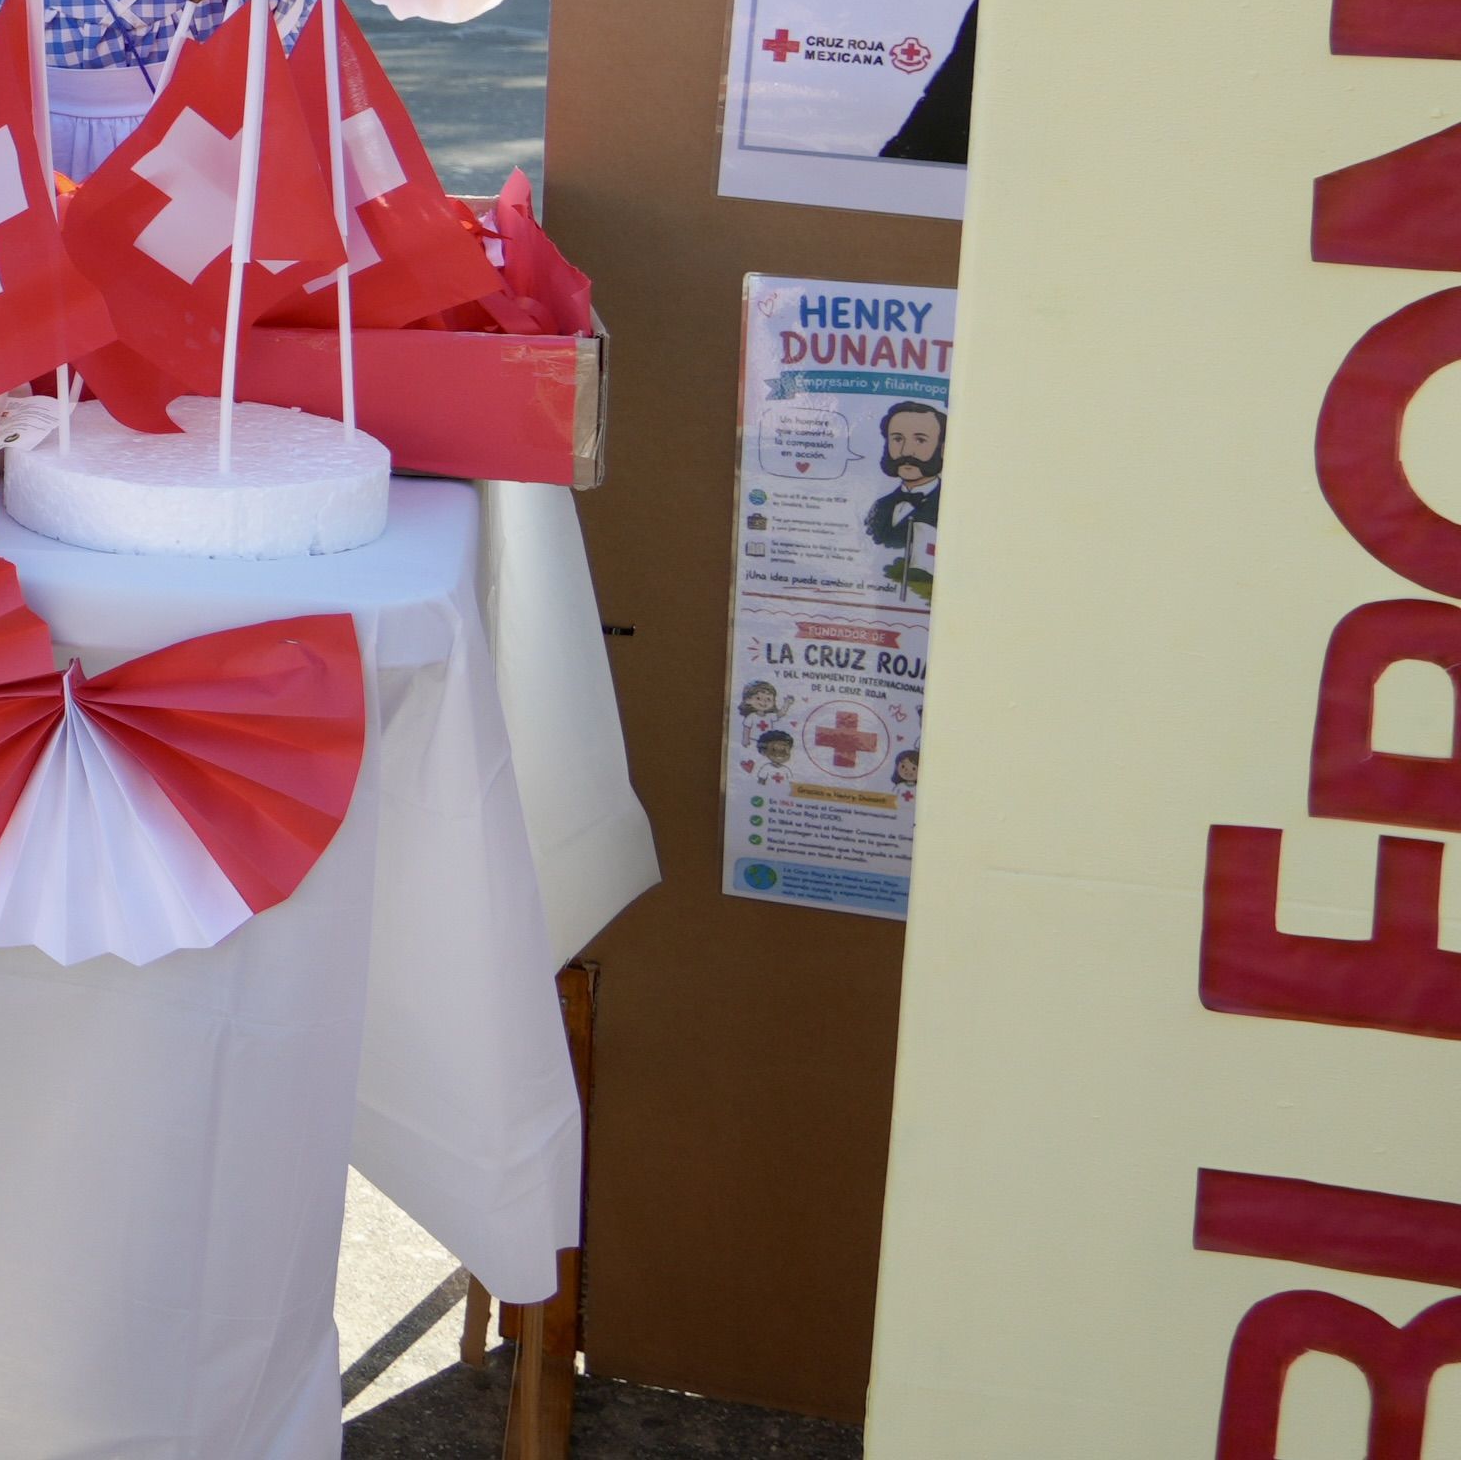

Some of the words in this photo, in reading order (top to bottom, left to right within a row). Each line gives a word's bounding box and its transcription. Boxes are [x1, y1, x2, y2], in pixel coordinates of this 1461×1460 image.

[806, 35, 843, 50] CRUZ
[847, 38, 886, 53] ROJA
[806, 50, 884, 67] MEXICANA
[800, 294, 932, 334] HENRY
[780, 331, 953, 372] DUNANT
[796, 375, 867, 388] Empresario
[872, 380, 879, 390] y
[885, 378, 947, 395] filántropo
[766, 643, 793, 664] LA
[805, 644, 866, 671] CRUZ
